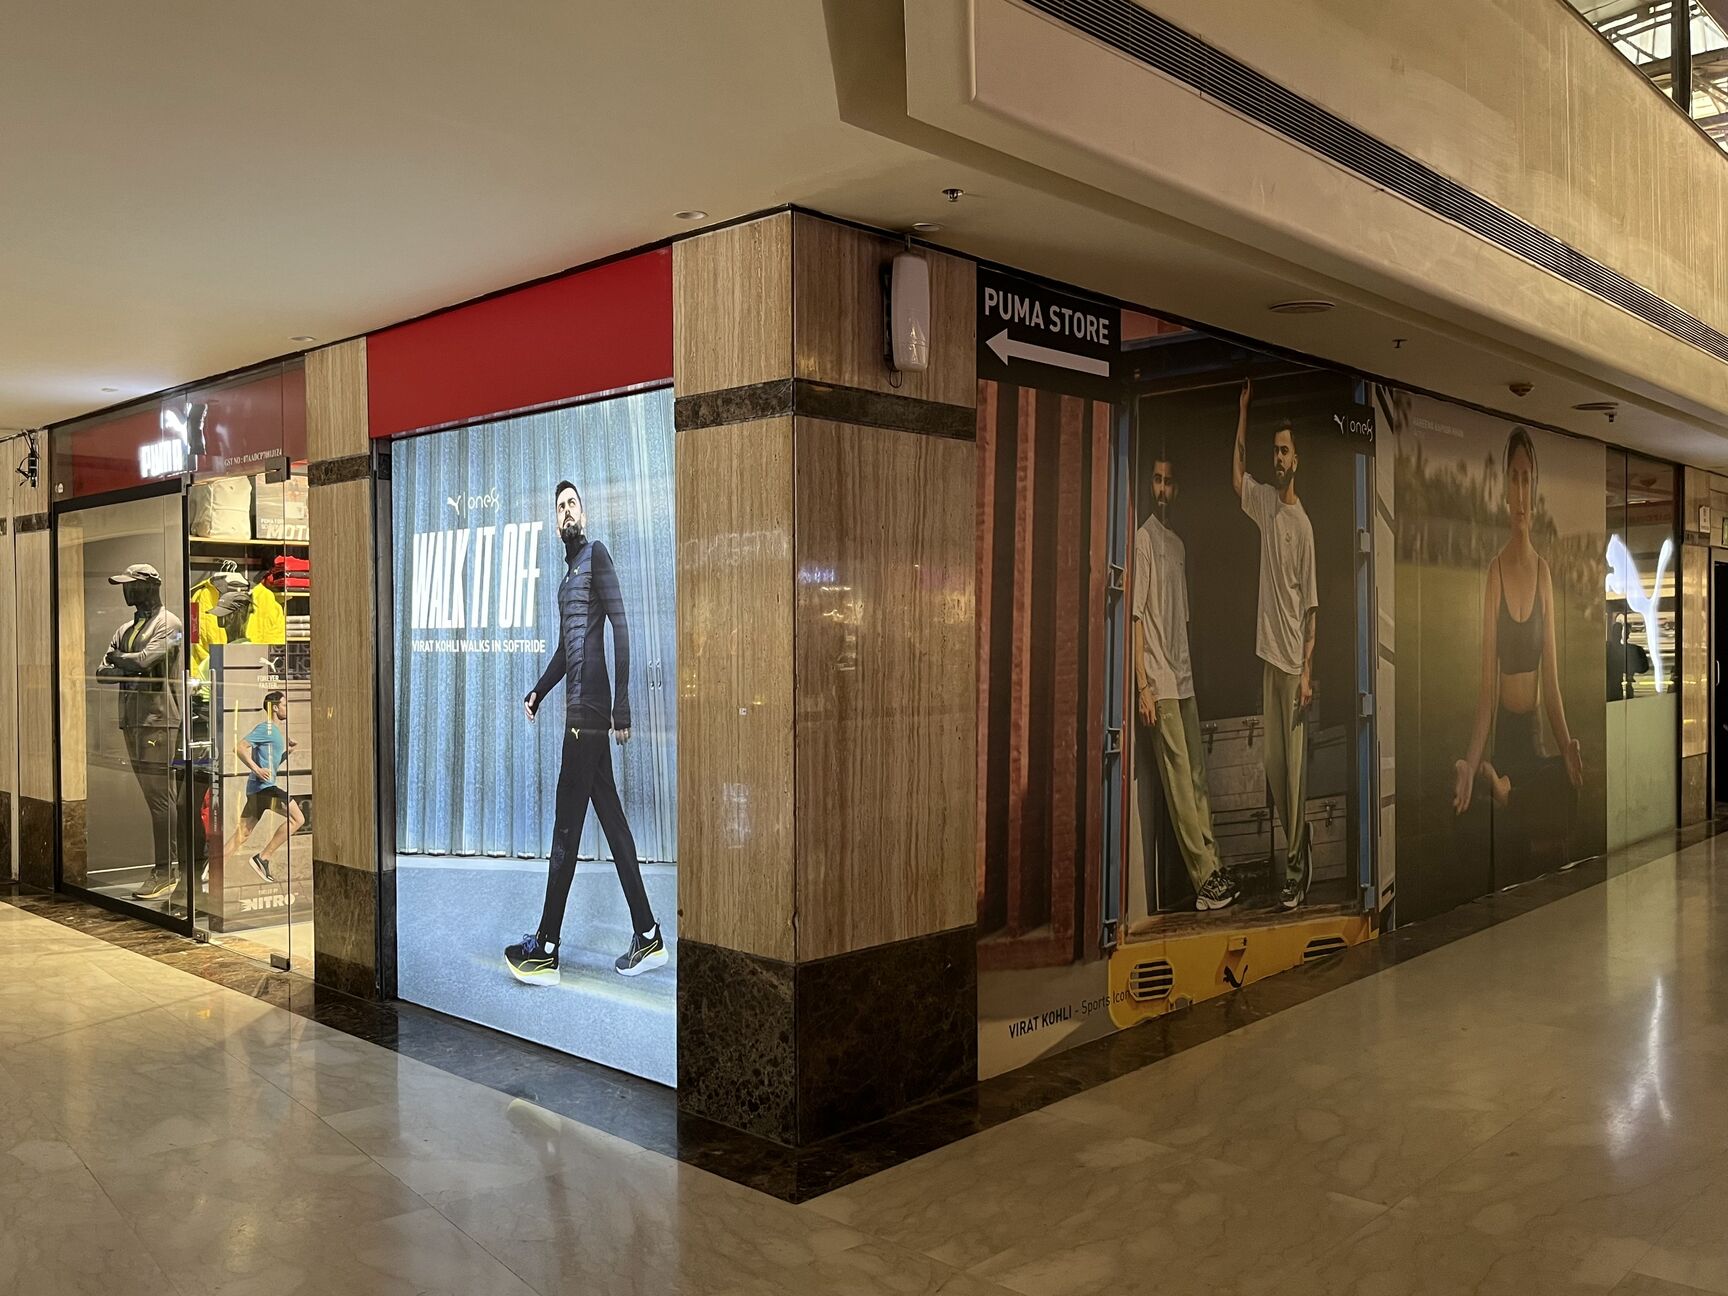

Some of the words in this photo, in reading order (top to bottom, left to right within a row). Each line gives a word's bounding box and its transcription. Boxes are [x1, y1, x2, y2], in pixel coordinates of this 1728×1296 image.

[985, 287, 1044, 329] PUMA
[1050, 305, 1110, 345] STORE
[138, 439, 183, 478] PUMA
[266, 524, 309, 540] MOT
[411, 528, 469, 629] WALK
[471, 525, 497, 628] IT
[499, 521, 543, 629] OFF
[412, 639, 434, 653] VIRAT
[435, 639, 459, 653] KOHLI
[460, 639, 490, 653] WALKS
[492, 639, 501, 653] IN
[503, 639, 546, 653] SOFTRIDE
[239, 893, 296, 912] NITRO
[1008, 1016, 1039, 1039] VIRAT
[1041, 1005, 1072, 1029] KOHLI
[1081, 996, 1110, 1015] Sports
